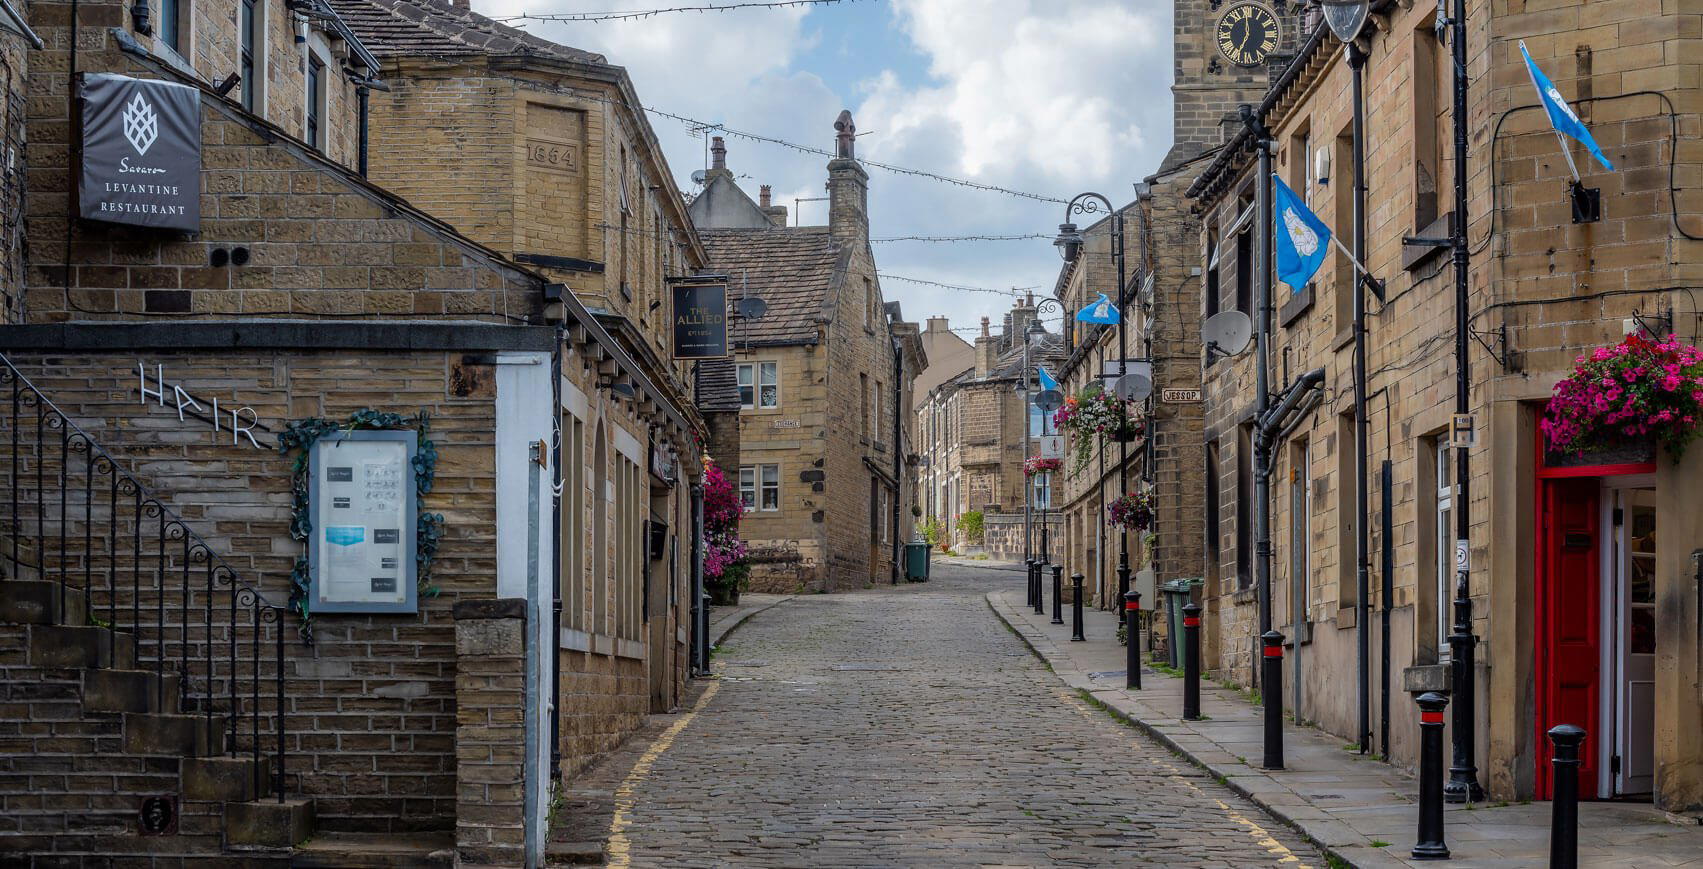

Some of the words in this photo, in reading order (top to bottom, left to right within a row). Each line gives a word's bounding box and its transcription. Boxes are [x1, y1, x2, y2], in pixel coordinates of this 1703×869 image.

[104, 182, 179, 196] LEVANTINE
[100, 201, 185, 215] RESTAURANT
[690, 307, 709, 315] THE
[677, 314, 723, 325] ALLIED
[139, 362, 261, 449] HAIR
